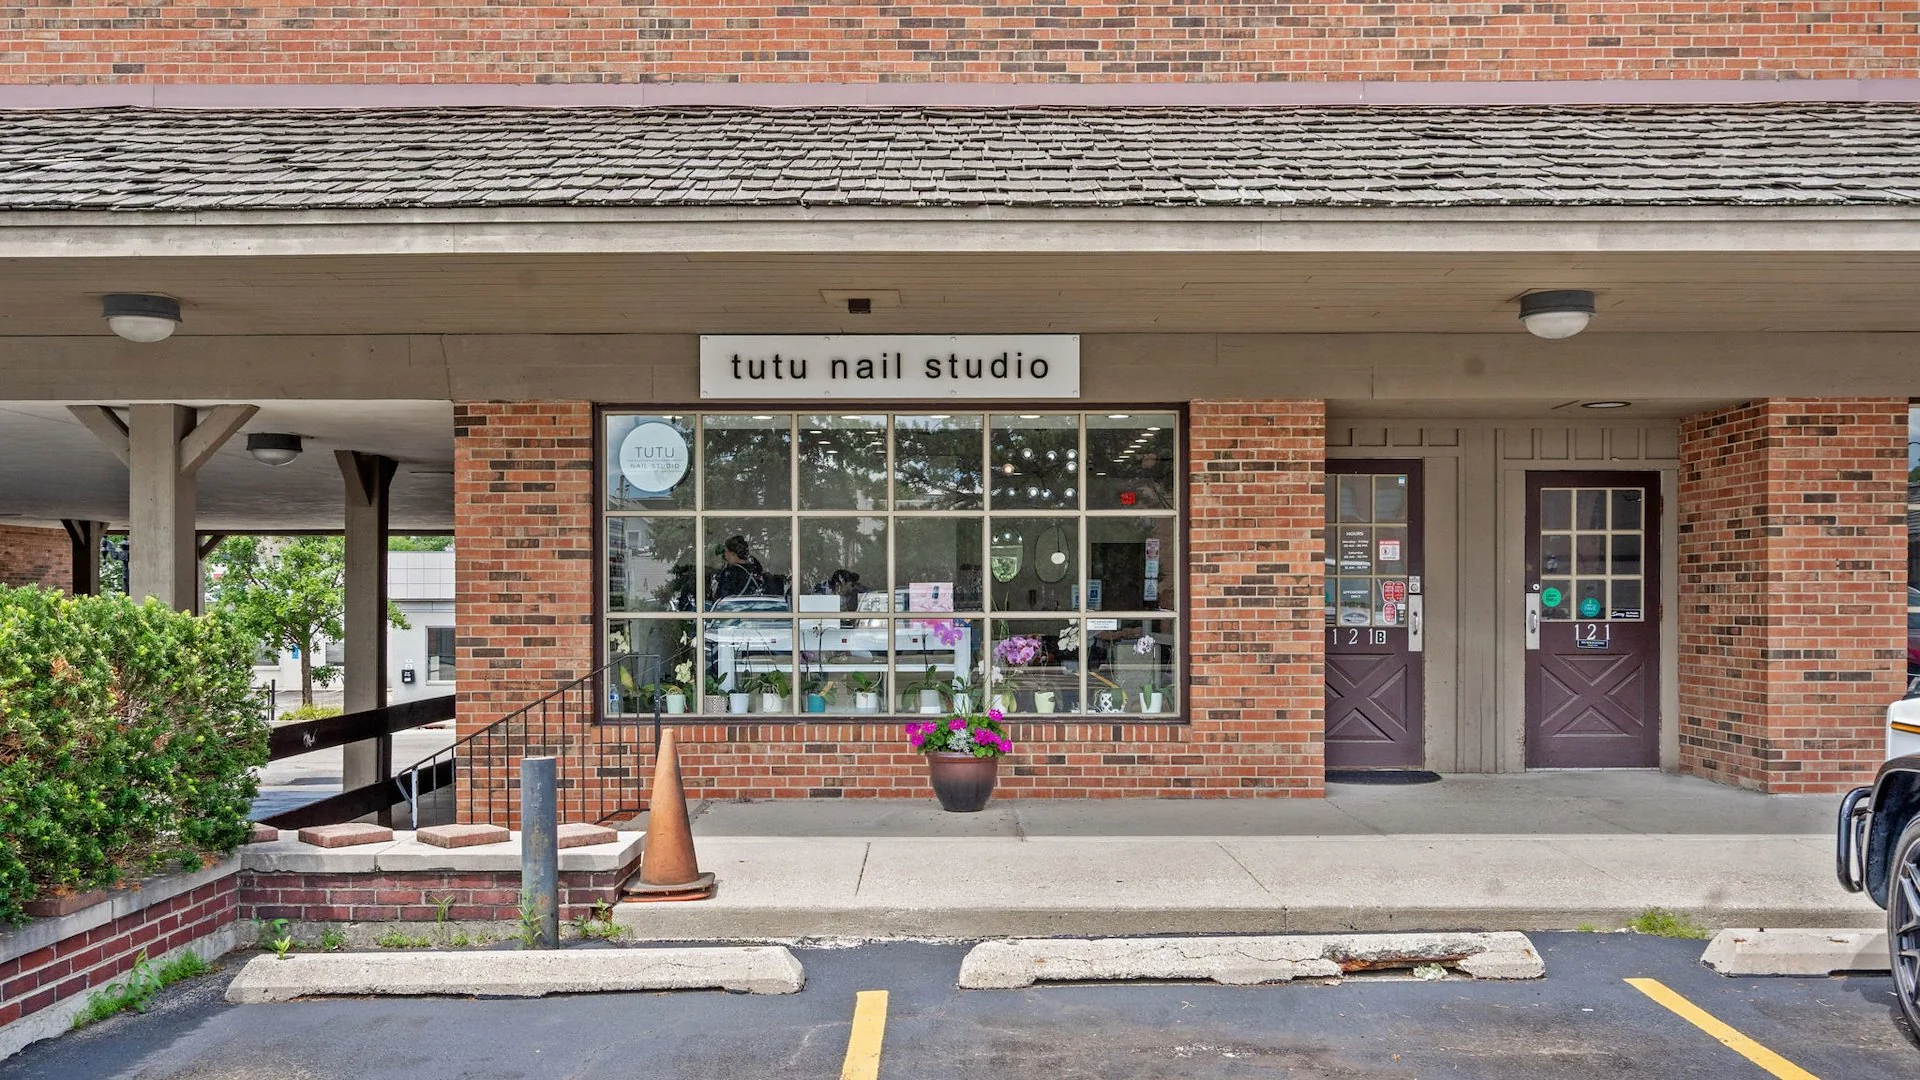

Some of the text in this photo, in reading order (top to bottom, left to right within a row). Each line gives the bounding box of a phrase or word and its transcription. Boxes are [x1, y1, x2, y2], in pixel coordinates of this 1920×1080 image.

[731, 352, 1049, 379] tutu nail studio
[634, 446, 675, 458] TUTU
[1574, 623, 1610, 640] 121
